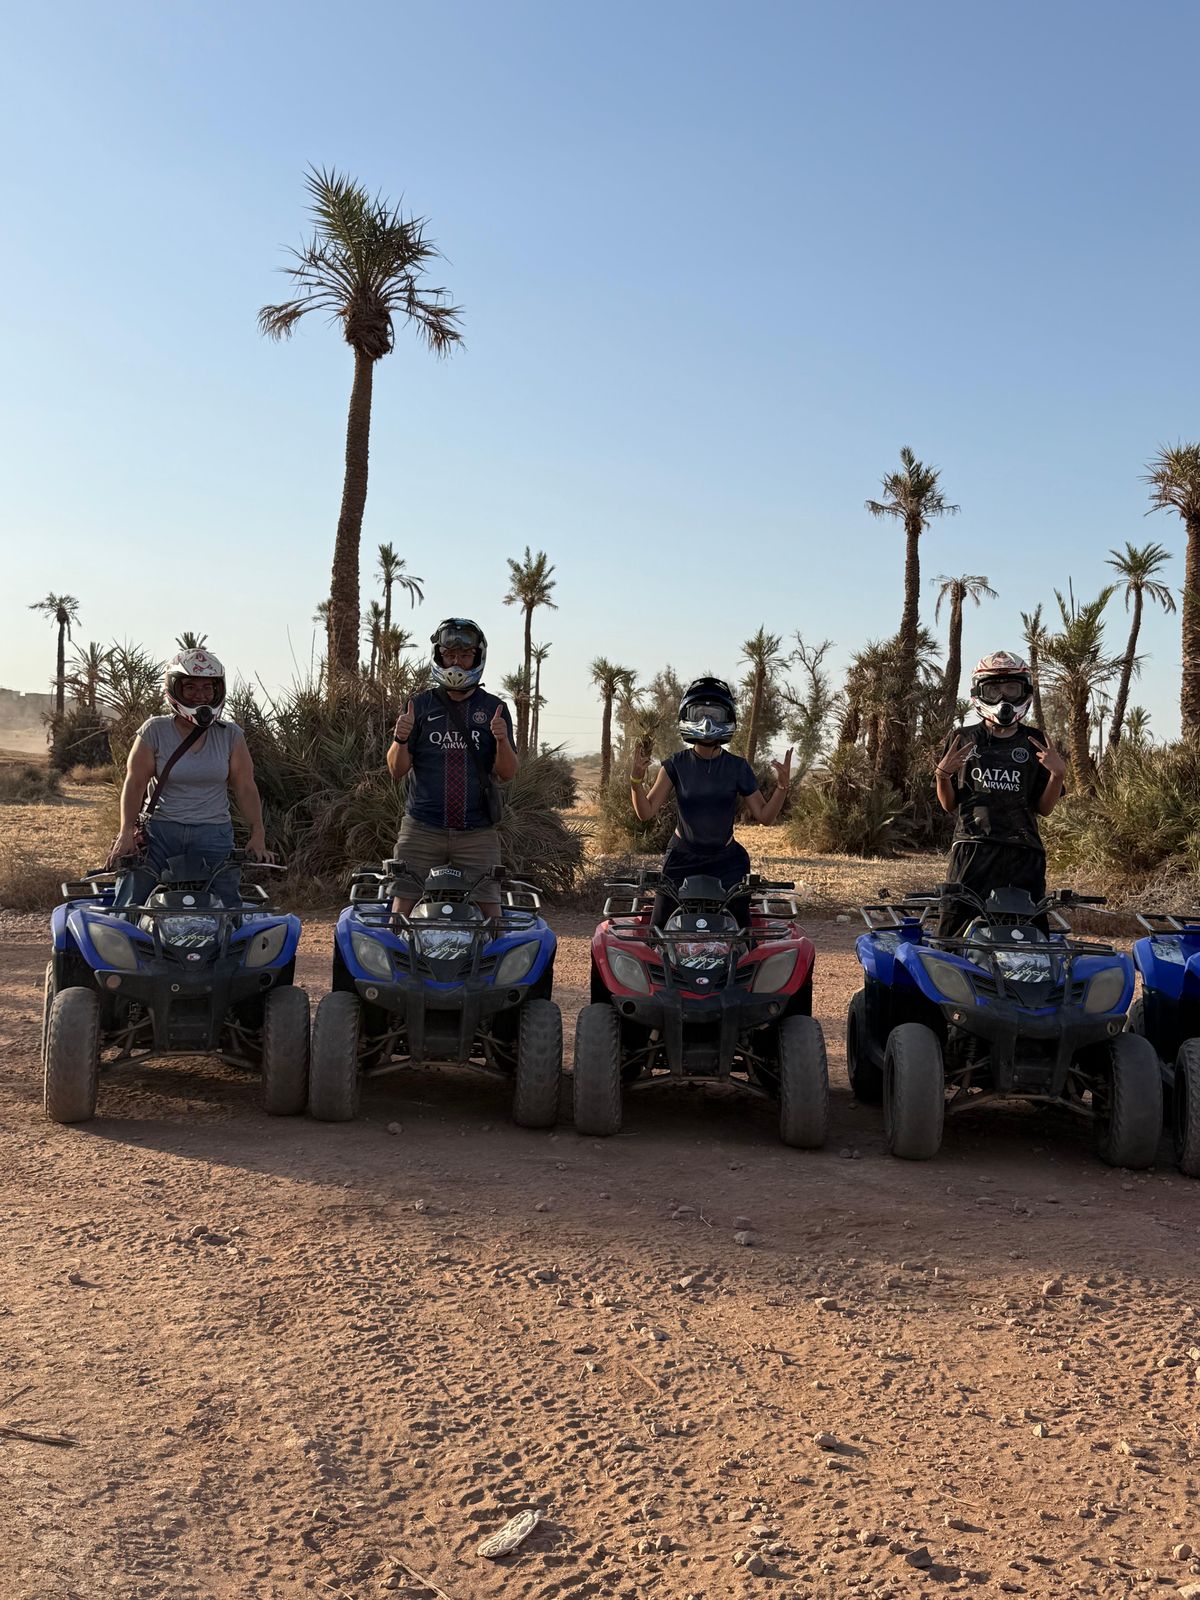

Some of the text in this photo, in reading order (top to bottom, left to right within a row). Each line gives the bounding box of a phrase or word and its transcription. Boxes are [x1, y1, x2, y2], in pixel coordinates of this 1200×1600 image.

[429, 731, 480, 744] QATR
[441, 742, 480, 750] AIRWS
[971, 767, 1021, 783] QATAR
[983, 780, 1021, 792] AIRWAYS
[170, 933, 215, 943] KYMCO
[423, 946, 468, 956] KYMCO
[681, 956, 725, 966] KYMCO
